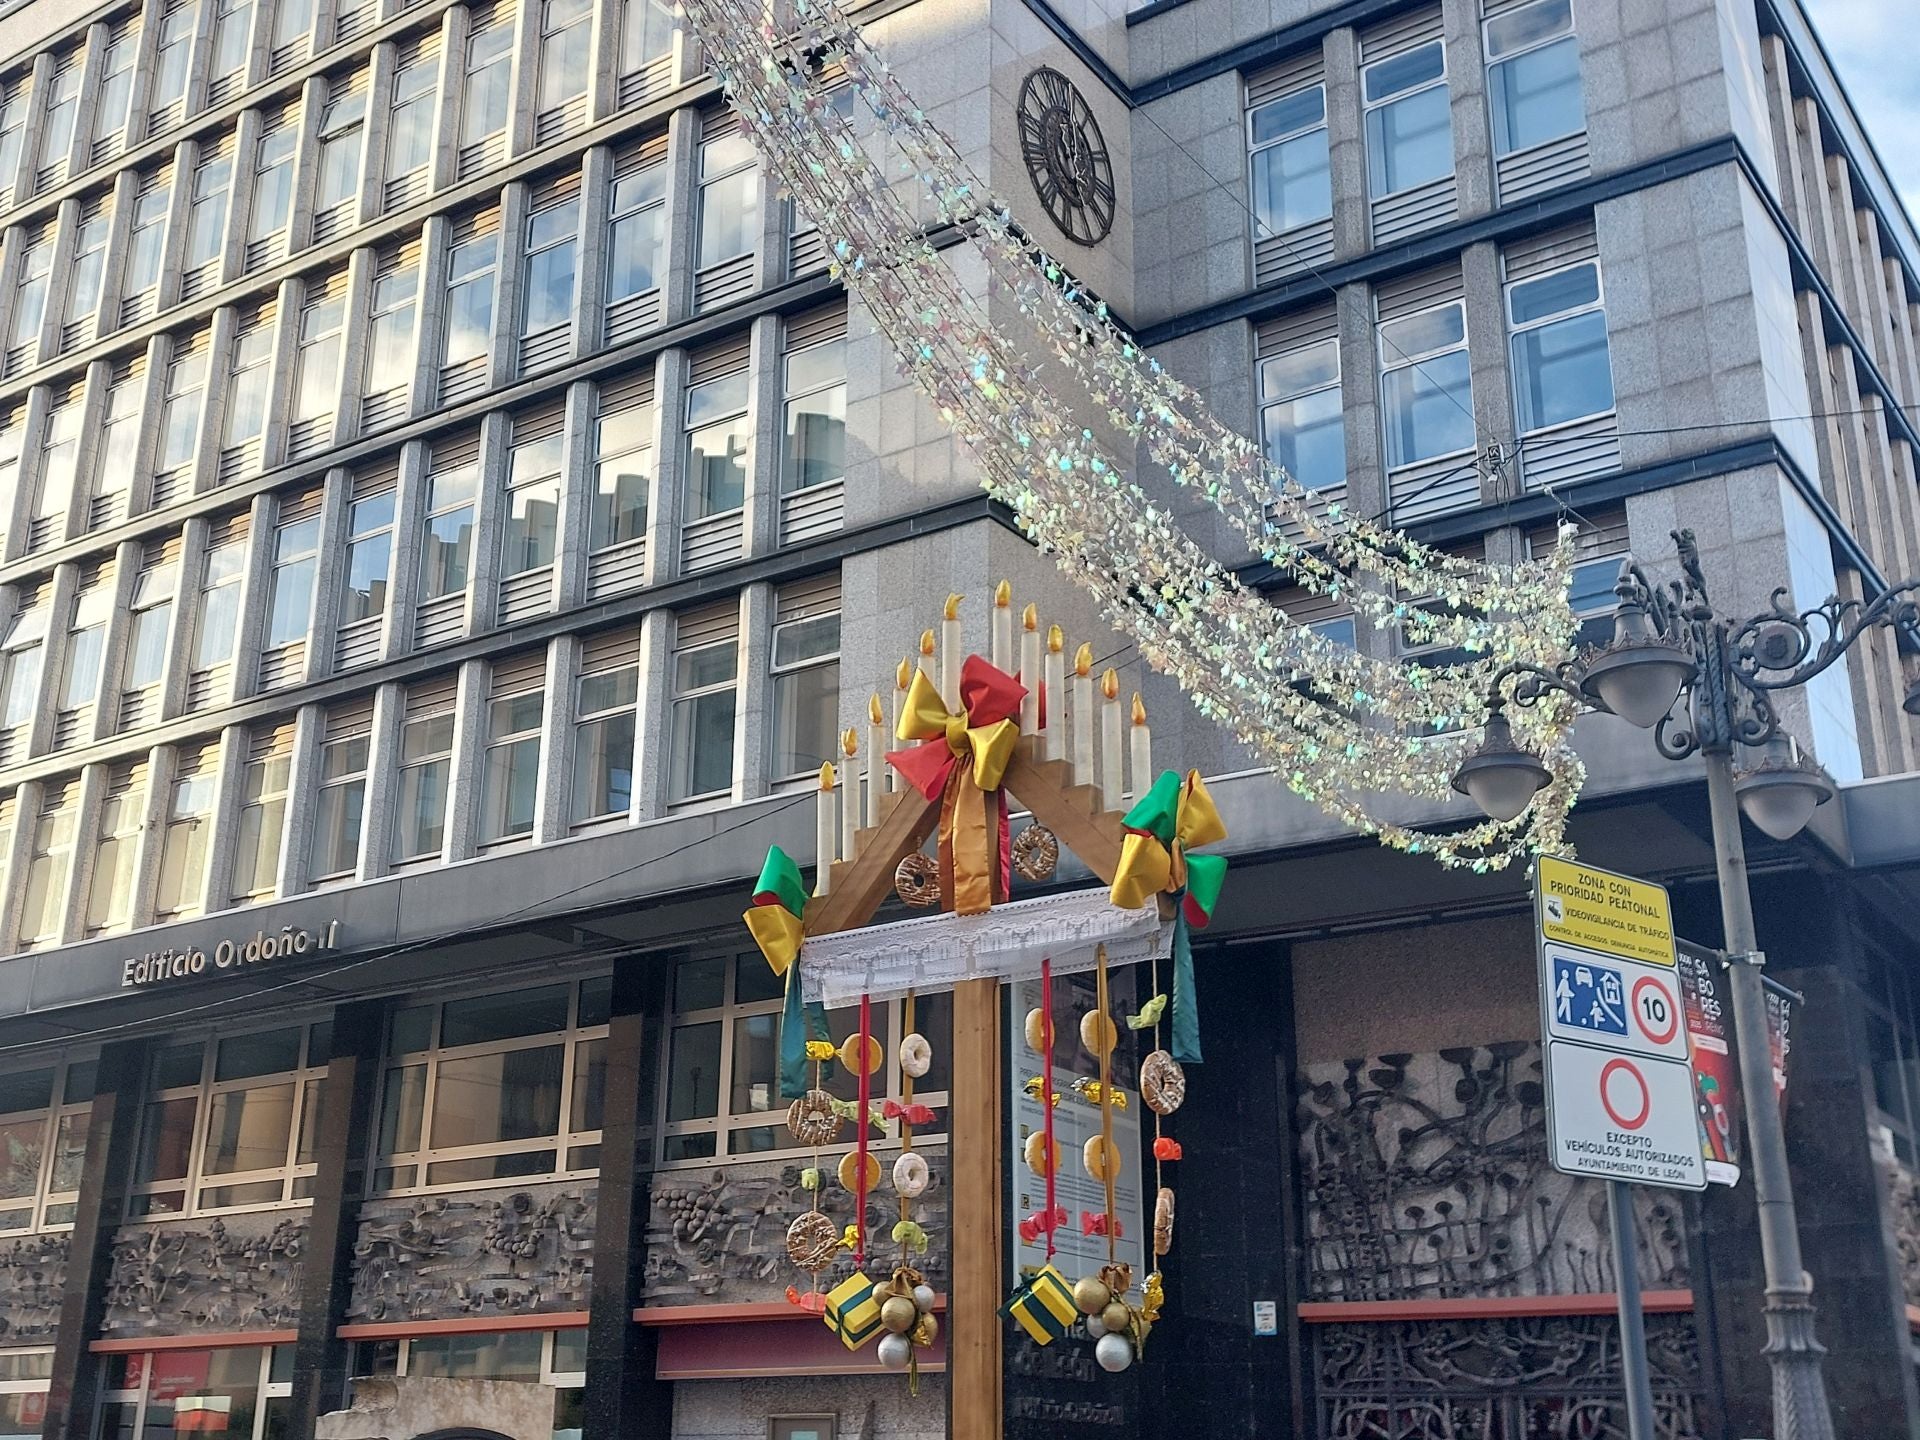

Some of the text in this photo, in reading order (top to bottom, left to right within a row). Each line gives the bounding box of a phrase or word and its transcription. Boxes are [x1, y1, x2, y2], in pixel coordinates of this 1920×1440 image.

[1578, 873, 1631, 897] ZONA CON
[1550, 880, 1660, 919] PRIORIDAD PEATONAL
[1565, 906, 1625, 929] VIDEOVIGILANCIA
[1628, 923, 1637, 933] DE
[121, 945, 206, 987] Edificio
[214, 924, 308, 968] Ordoño
[1694, 958, 1710, 978] SA
[1698, 977, 1714, 997] BO
[1643, 996, 1666, 1022] 10
[1700, 996, 1722, 1018] RES
[1606, 1132, 1652, 1148] EXCEPTO
[1565, 1139, 1694, 1166] VEHÍCULOS AUTORIZADOS
[1578, 1157, 1644, 1175] AYUNTAMIENTO
[1648, 1166, 1660, 1176] DE
